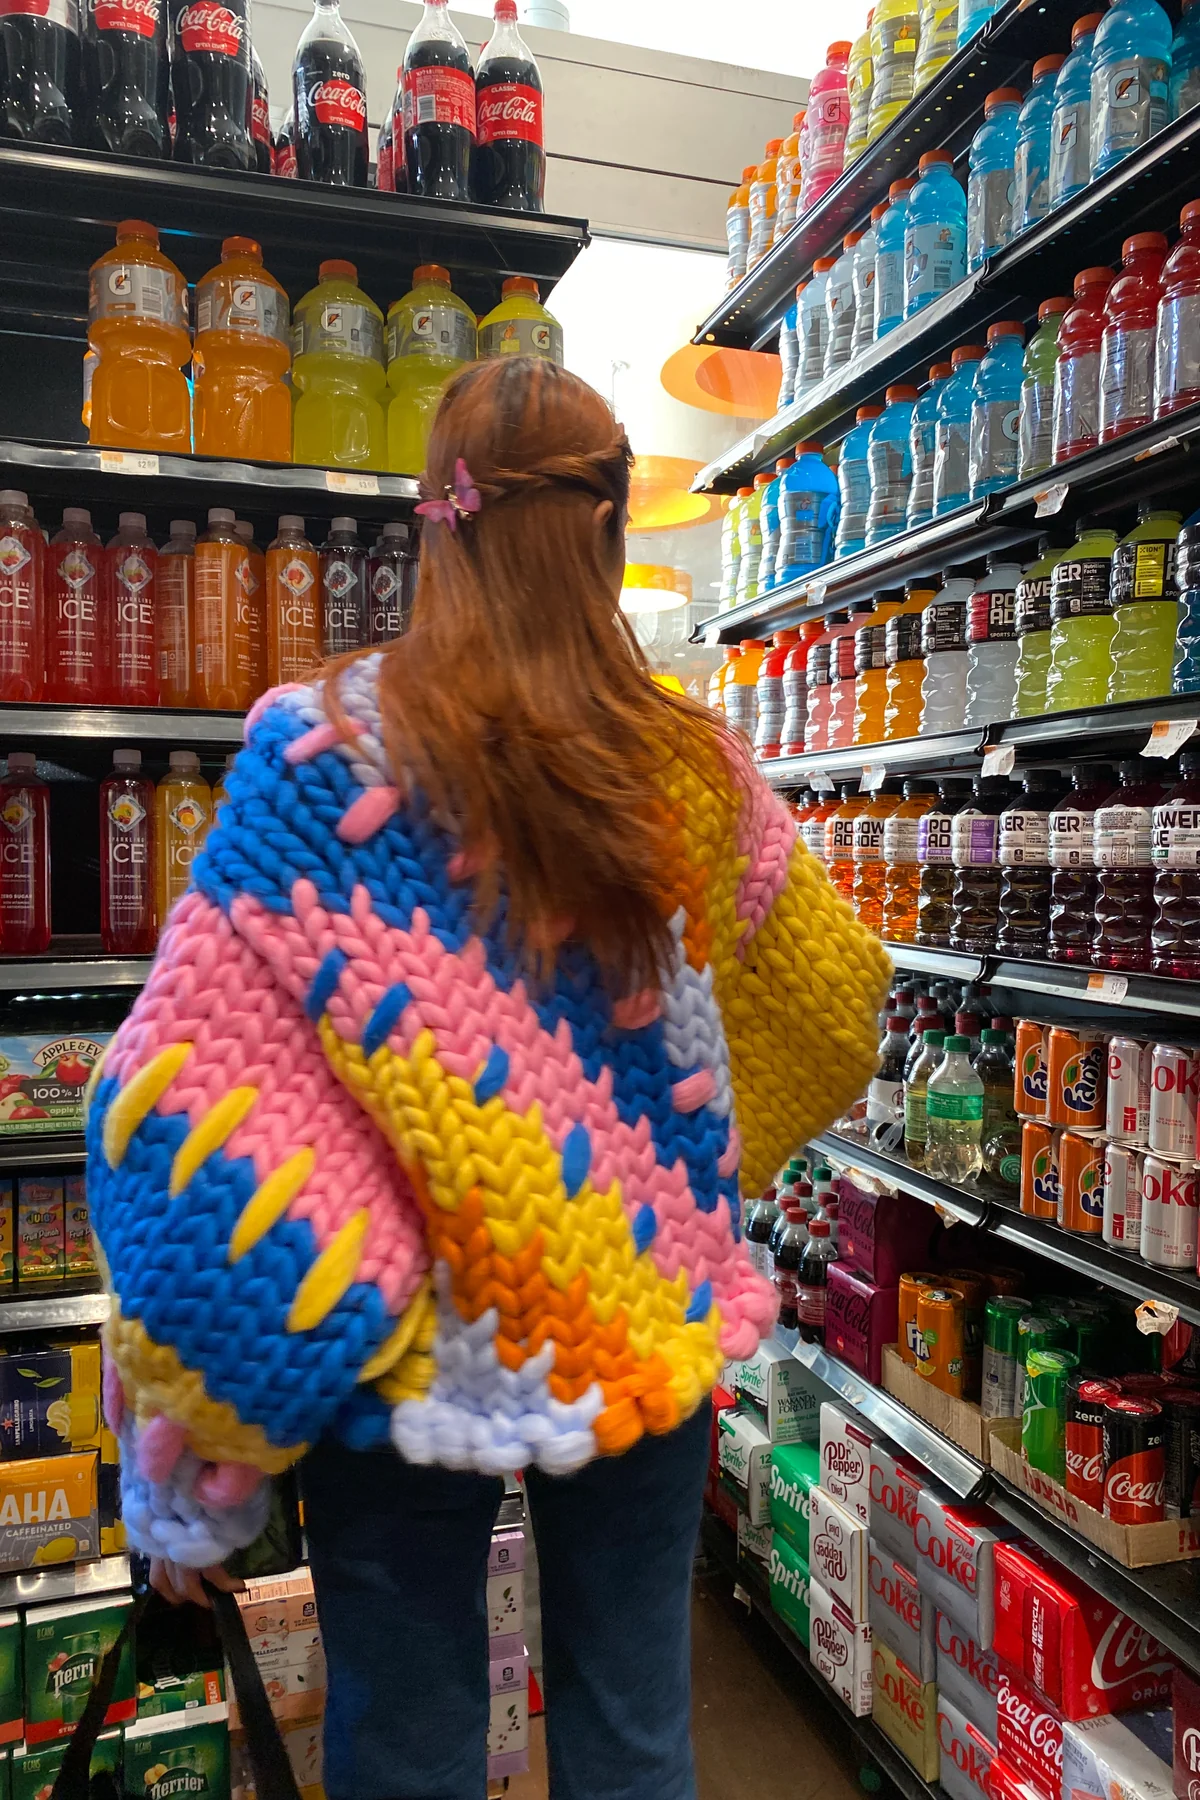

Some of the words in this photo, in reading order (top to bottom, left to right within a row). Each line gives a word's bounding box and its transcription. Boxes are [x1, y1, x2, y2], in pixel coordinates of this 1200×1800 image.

[176, 5, 245, 39] Coca-Cola
[332, 70, 350, 80] zero
[307, 80, 366, 118] Coca-Cola
[491, 85, 517, 94] CLASSIC
[477, 96, 537, 128] Coca-Cola
[58, 600, 94, 621] ICE
[117, 602, 153, 624] ICE
[281, 606, 314, 628] ICE
[324, 608, 357, 629] ICE
[372, 612, 400, 632] ICE
[1, 843, 34, 863] ICE
[42, 1041, 77, 1065] APPLE
[77, 1042, 86, 1051] &
[86, 1043, 103, 1057] EV
[32, 1088, 72, 1099] 100%
[50, 1107, 74, 1115] apple
[1143, 1169, 1198, 1207] oke
[740, 1365, 762, 1389] Sprite
[777, 1371, 790, 1382] 12
[777, 1394, 817, 1407] WAKANDA
[779, 1403, 816, 1415] FOREVER
[1074, 1410, 1103, 1424] zero
[722, 1445, 743, 1470] Sprite
[769, 1464, 811, 1521] Sprite
[830, 1483, 843, 1496] Diet
[0, 1488, 72, 1526] AHA
[855, 1502, 867, 1520] 12
[6, 1522, 72, 1538] CAFFEINATED
[913, 1513, 977, 1594] Coke
[953, 1539, 974, 1562] Diet
[870, 1555, 921, 1633] Coke
[1031, 1596, 1040, 1646] RECYCLE
[1037, 1632, 1044, 1651] ME
[936, 1611, 999, 1697] Coke
[819, 1659, 832, 1676] Diet
[872, 1650, 925, 1731] Coke
[1000, 1723, 1038, 1762] ORIGINAL
